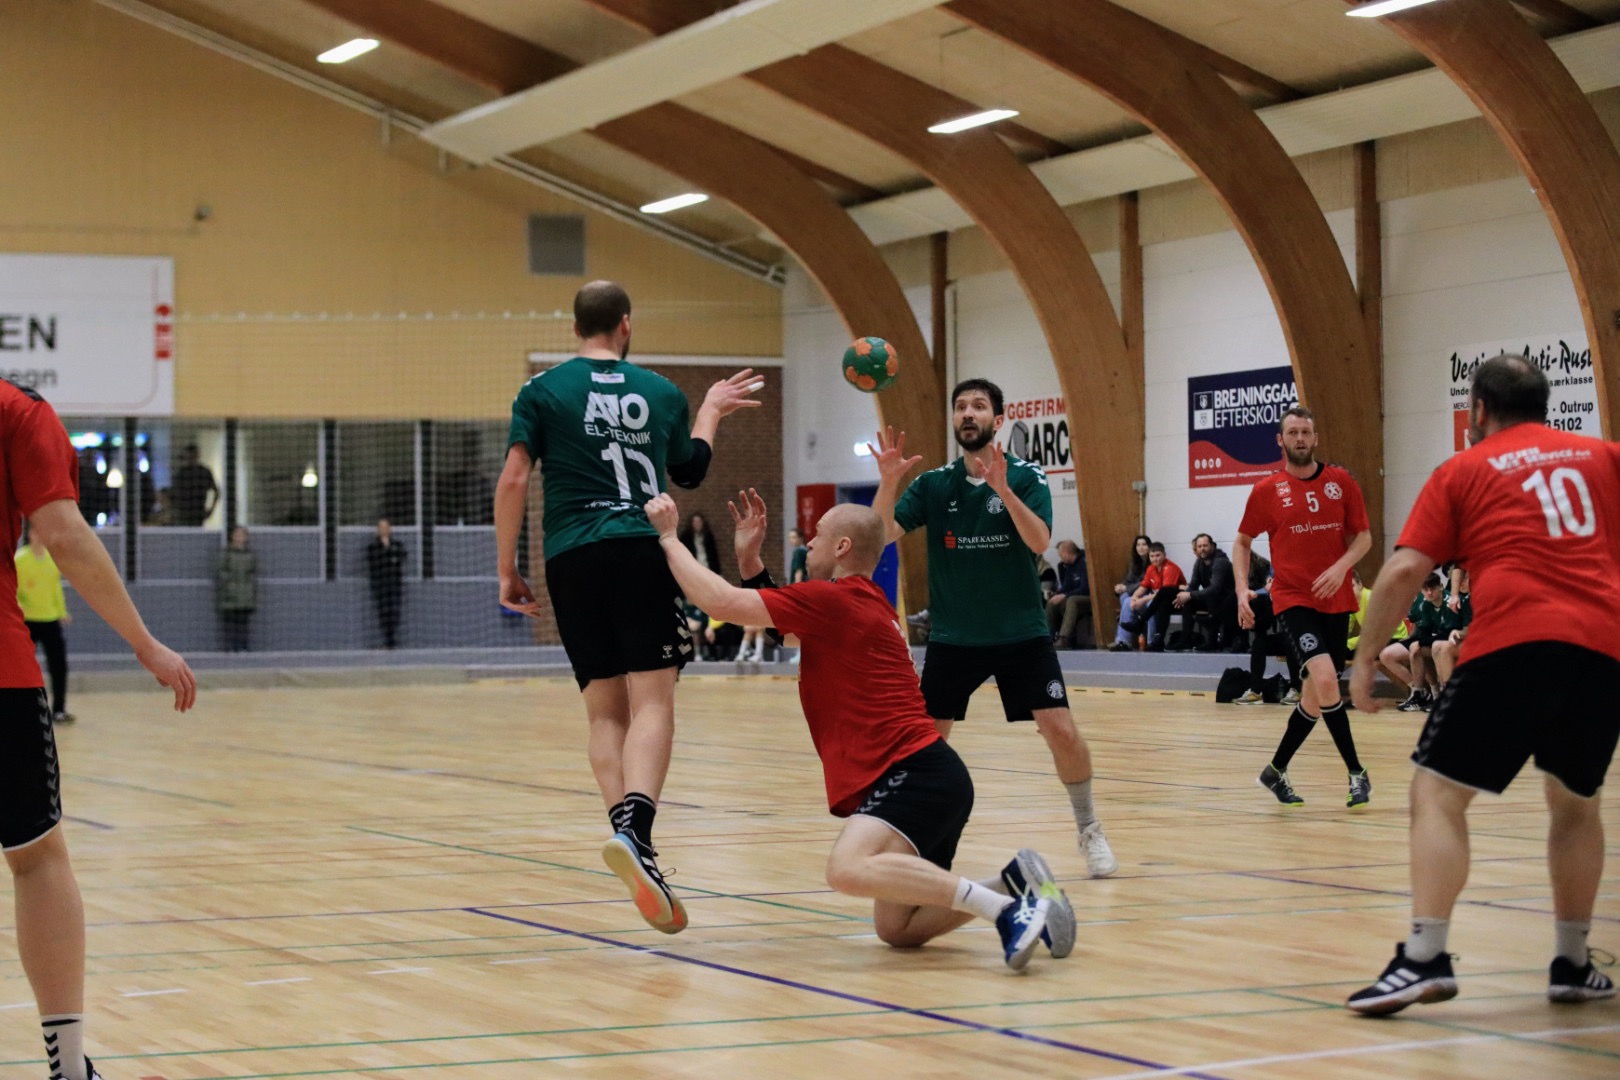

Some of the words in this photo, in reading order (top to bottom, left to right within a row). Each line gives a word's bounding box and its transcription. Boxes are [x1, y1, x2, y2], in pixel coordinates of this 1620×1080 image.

[0, 315, 57, 350] EN
[1560, 401, 1594, 414] Outrup
[584, 423, 652, 445] EL-TEKNIK
[1031, 420, 1073, 466] ARC
[1305, 491, 1320, 513] 5
[1521, 467, 1597, 539] 10
